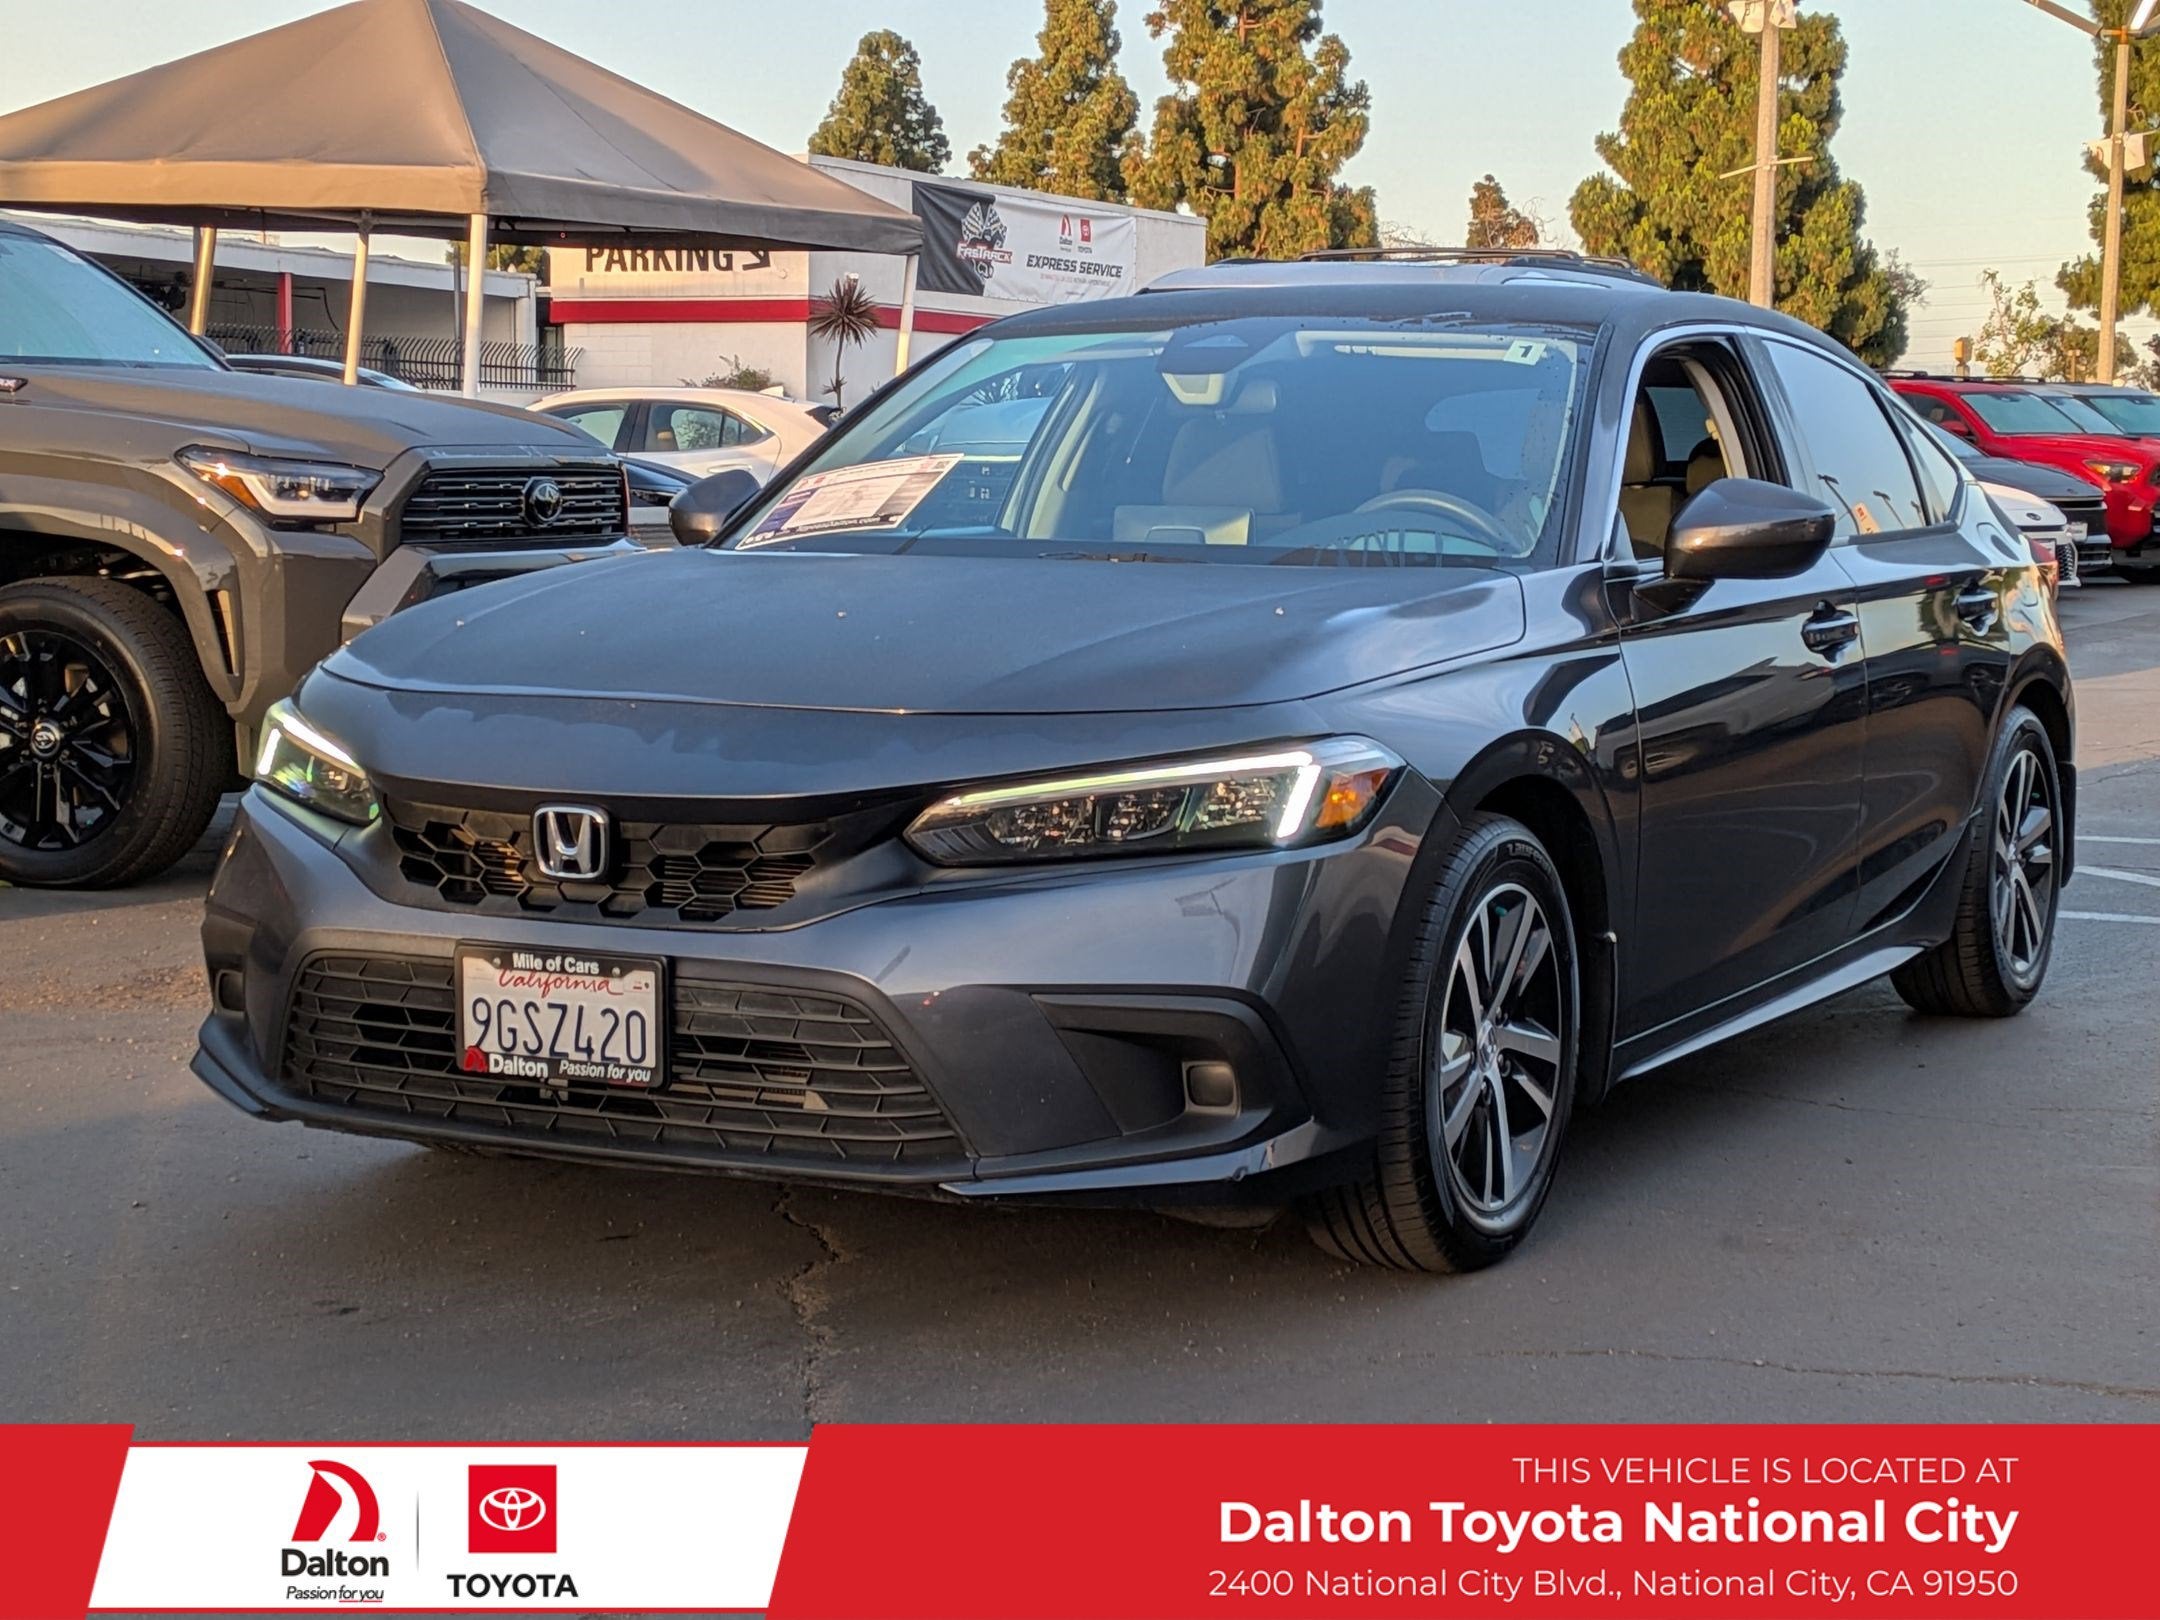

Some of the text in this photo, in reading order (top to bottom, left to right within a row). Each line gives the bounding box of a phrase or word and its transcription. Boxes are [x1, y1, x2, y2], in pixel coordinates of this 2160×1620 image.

[585, 248, 733, 272] PARKING
[1026, 254, 1123, 278] EXPRESS SERVICE
[513, 952, 600, 974] Mile of Cars
[499, 968, 625, 998] California
[472, 997, 647, 1063] 9GSZ420
[489, 1055, 549, 1078] Dalton
[559, 1060, 651, 1083] Passion for you
